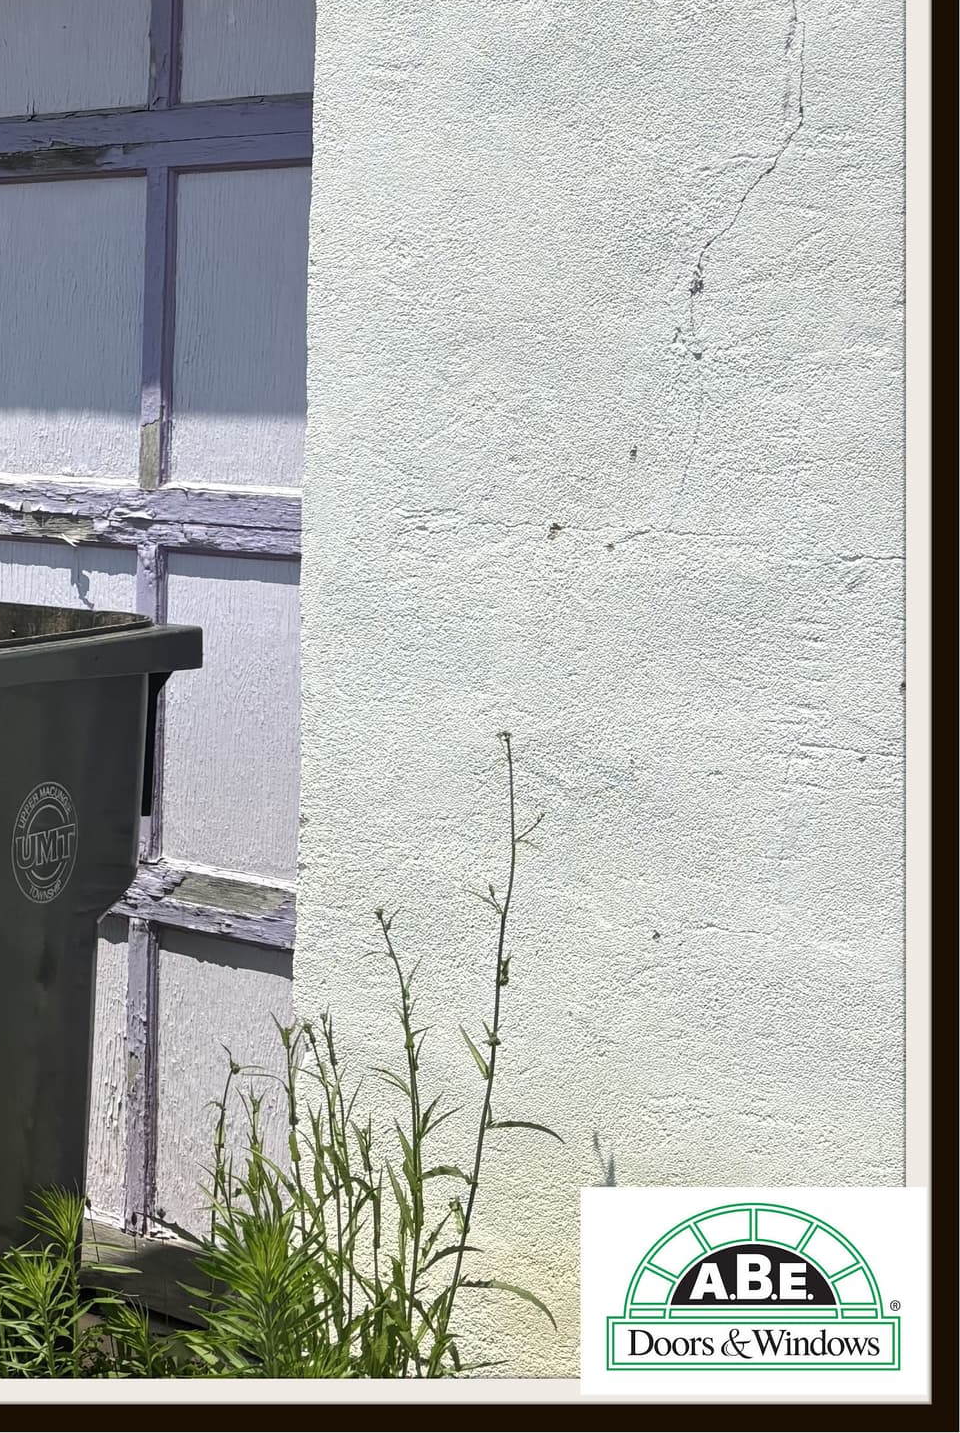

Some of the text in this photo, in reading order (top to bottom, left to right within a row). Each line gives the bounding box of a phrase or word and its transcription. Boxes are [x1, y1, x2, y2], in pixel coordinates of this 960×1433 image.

[17, 792, 39, 829] UPPER
[15, 823, 76, 870] UMT
[29, 878, 62, 901] TOWNSHIP
